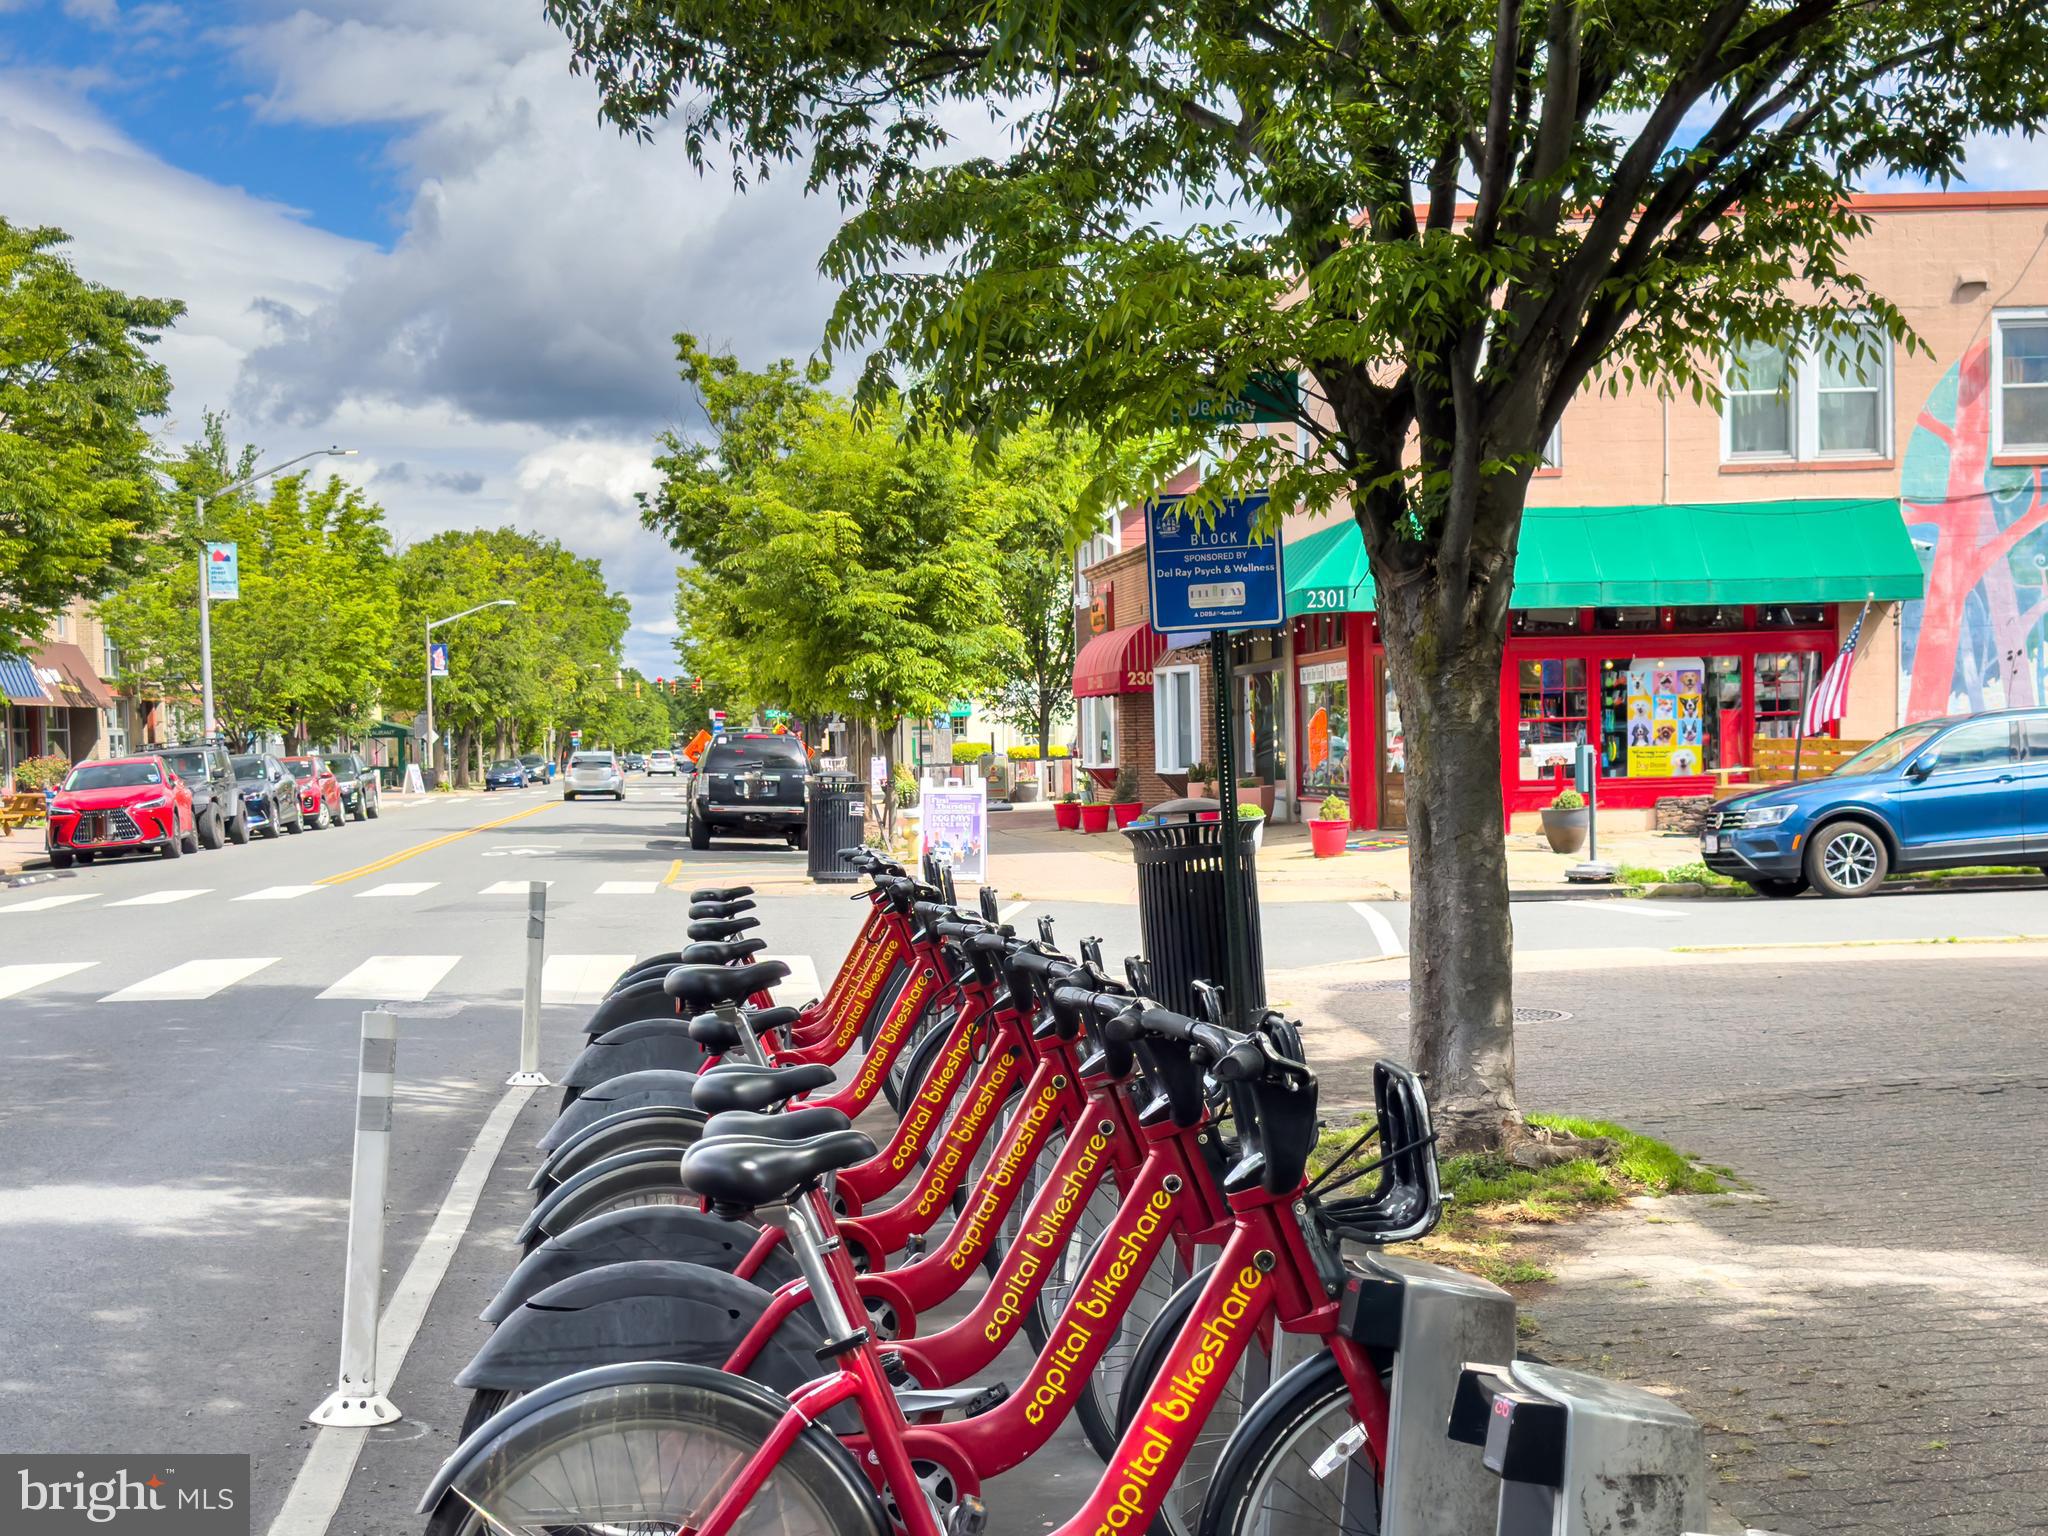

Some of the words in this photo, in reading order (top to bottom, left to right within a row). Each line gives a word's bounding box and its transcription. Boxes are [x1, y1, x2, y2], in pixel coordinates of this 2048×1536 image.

[1157, 568, 1173, 578] Del
[1175, 567, 1192, 579] Ray
[1194, 565, 1222, 577] Psych
[1223, 565, 1232, 574] &
[1233, 563, 1275, 573] Wellness
[1184, 552, 1234, 563] SPONSORED
[1236, 551, 1248, 560] BY
[1191, 532, 1238, 546] BLOCK
[1306, 589, 1345, 609] 2301
[837, 1000, 866, 1047] capital
[857, 940, 899, 999] bikeshare
[855, 1045, 889, 1100] capital
[880, 976, 928, 1044] bikeshare
[892, 1105, 932, 1170] capital
[922, 1022, 979, 1104] bikeshare
[917, 1144, 962, 1216] capital
[950, 1053, 1015, 1143] bikeshare
[950, 1188, 1000, 1270] capital
[986, 1086, 1057, 1187] bikeshare
[984, 1250, 1041, 1343] capital
[1026, 1134, 1107, 1248] bikeshare
[1025, 1320, 1092, 1425] capital
[1075, 1189, 1172, 1319] bikeshare
[1151, 1266, 1263, 1423] bikeshare
